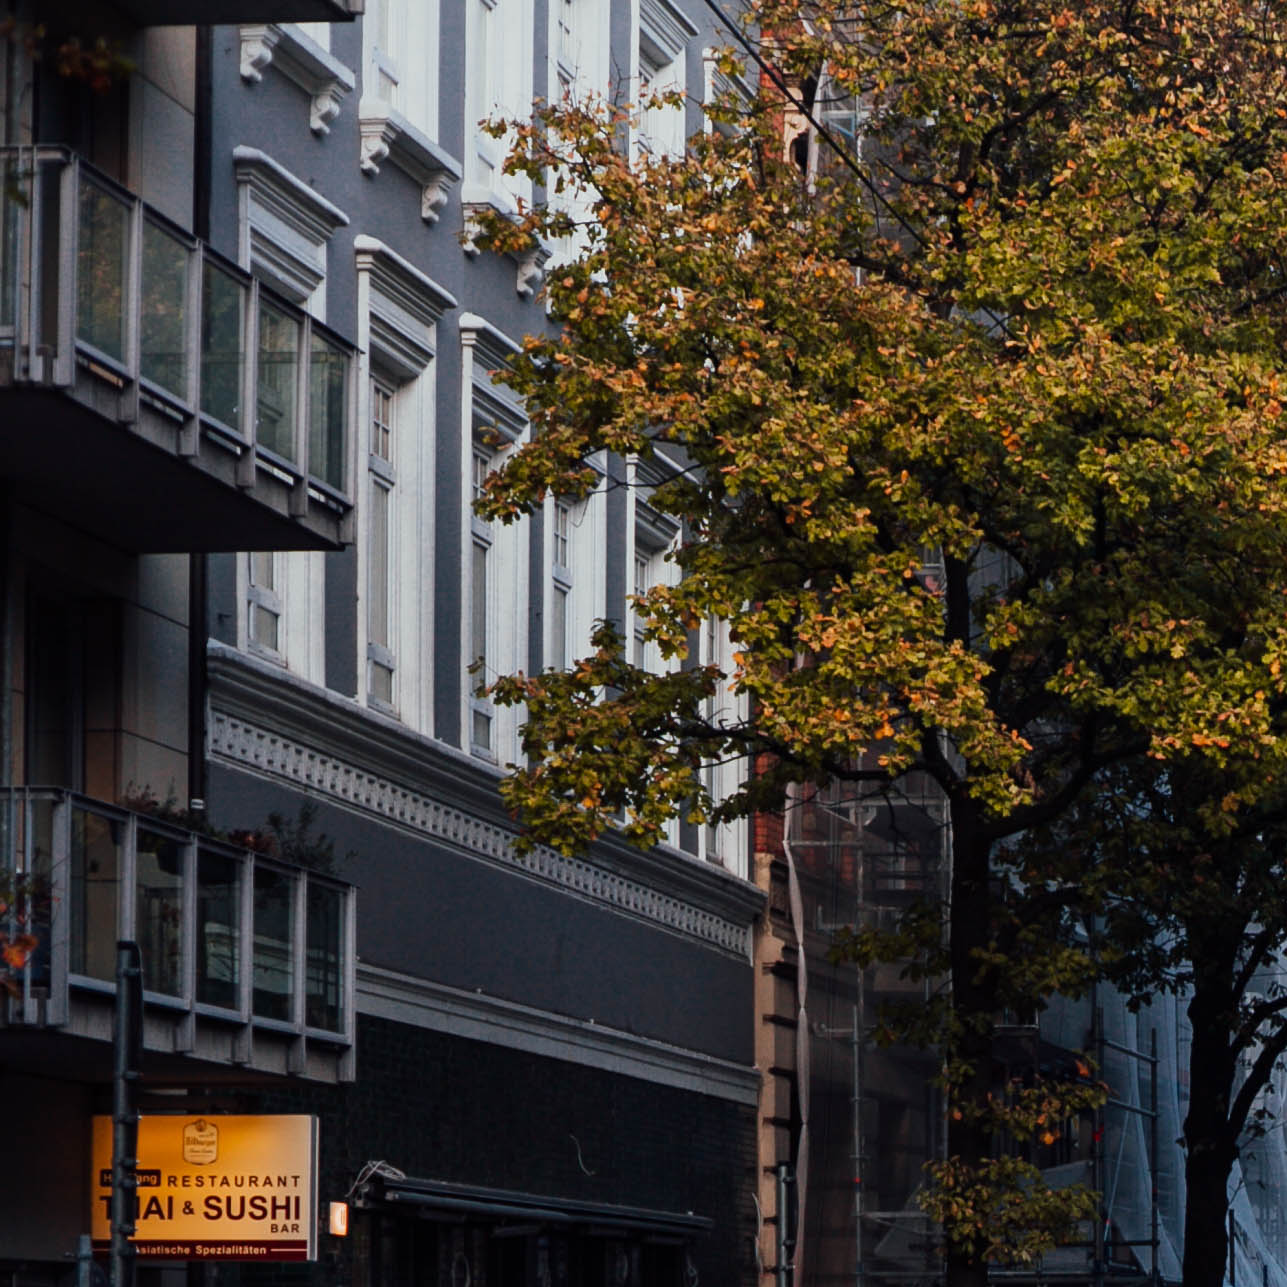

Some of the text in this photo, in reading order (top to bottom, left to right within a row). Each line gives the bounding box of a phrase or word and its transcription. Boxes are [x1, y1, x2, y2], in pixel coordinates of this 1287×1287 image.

[167, 1175, 301, 1188] RESTAURANT
[99, 1195, 301, 1221] TAI & SUSHI
[270, 1224, 301, 1234] BAR
[195, 1245, 267, 1256] Spezialitäten
